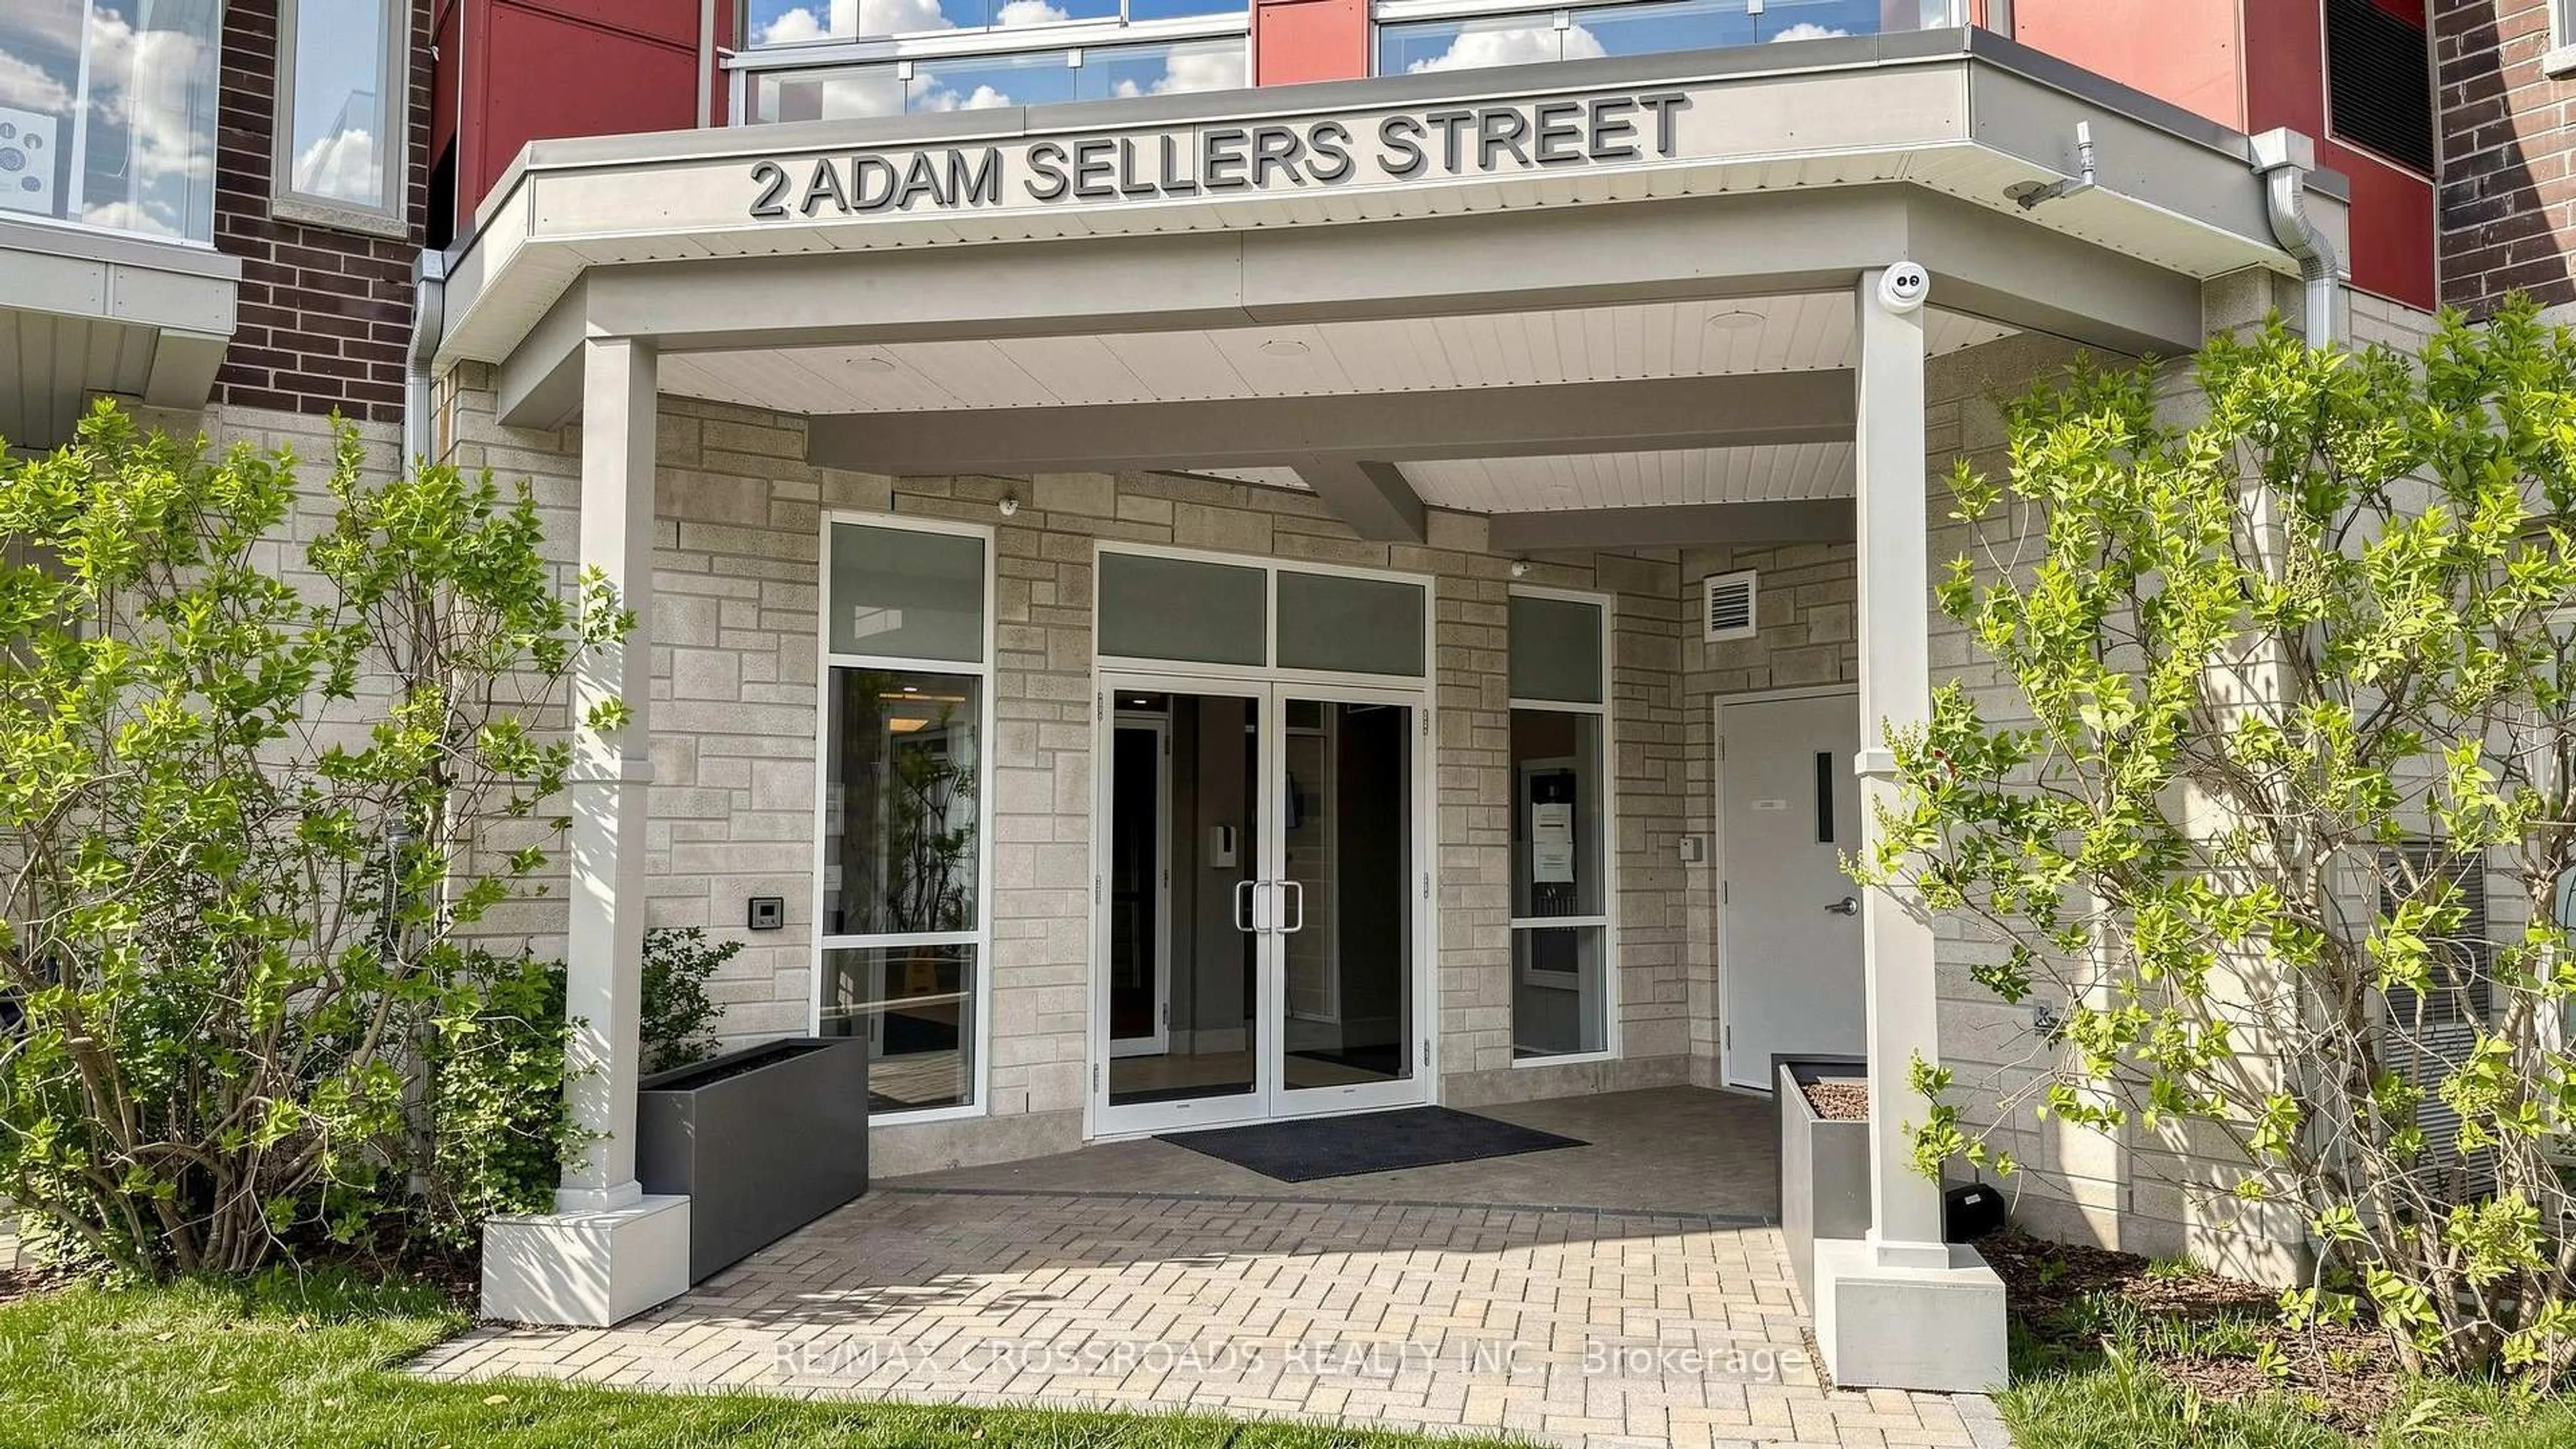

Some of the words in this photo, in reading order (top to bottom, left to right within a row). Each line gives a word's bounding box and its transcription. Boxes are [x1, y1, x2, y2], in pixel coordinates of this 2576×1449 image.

[750, 160, 784, 215] 2
[800, 146, 998, 212] ADAM
[1024, 121, 1350, 199] SELLERS
[1377, 92, 1686, 173] STREET
